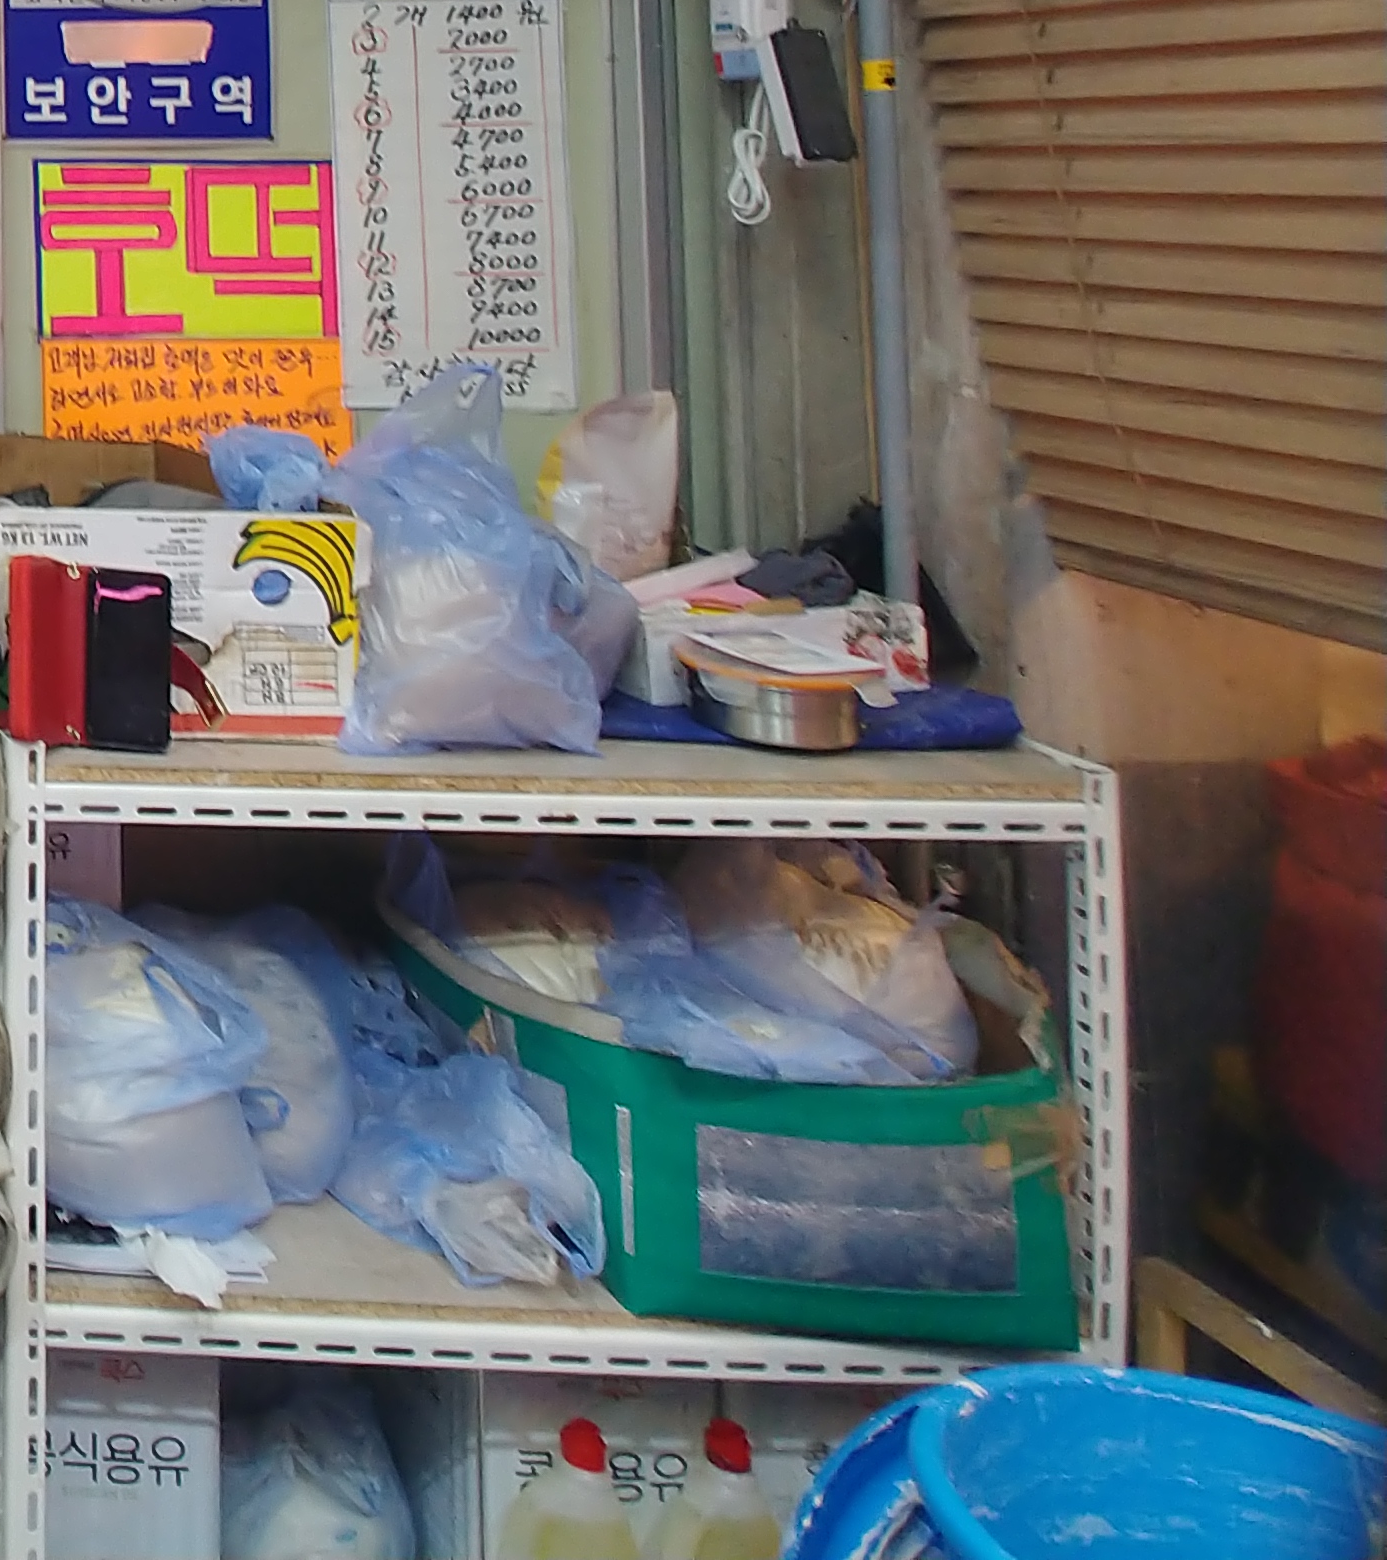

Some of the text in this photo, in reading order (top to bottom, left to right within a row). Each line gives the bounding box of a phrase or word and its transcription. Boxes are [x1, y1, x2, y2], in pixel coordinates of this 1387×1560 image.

[24, 76, 254, 125] 보안구역
[41, 164, 340, 337] 호떡
[515, 1448, 688, 1504] 콩용유
